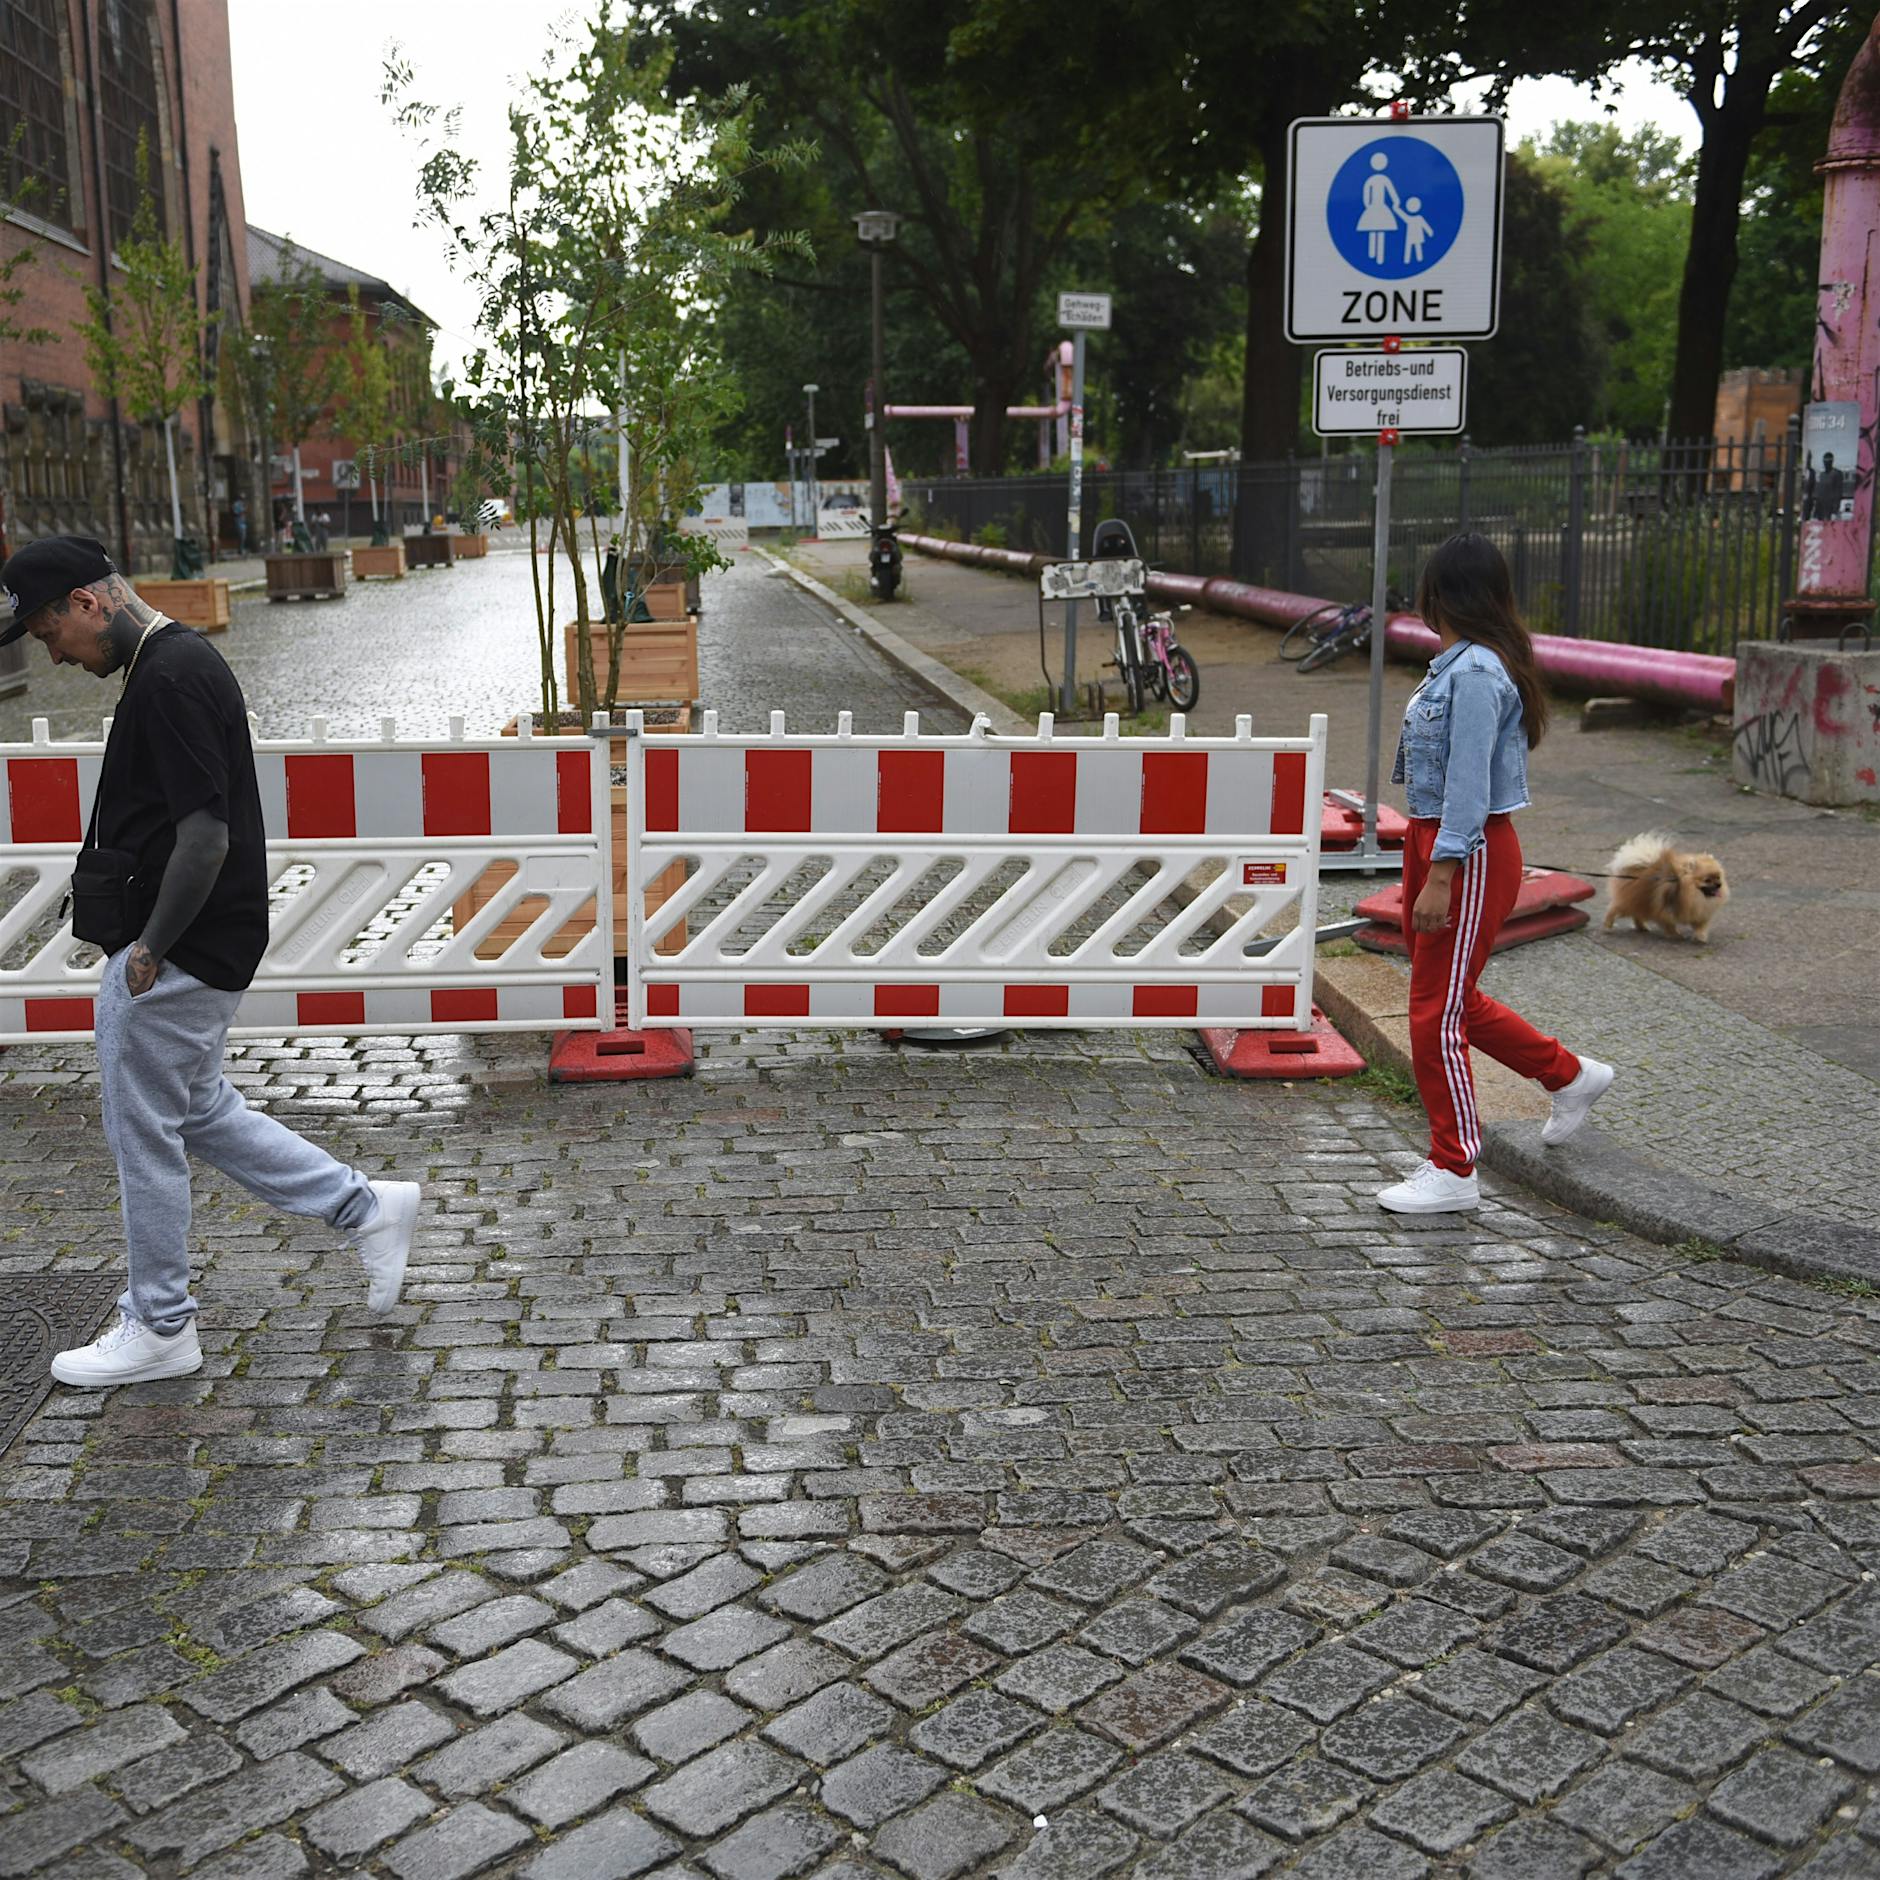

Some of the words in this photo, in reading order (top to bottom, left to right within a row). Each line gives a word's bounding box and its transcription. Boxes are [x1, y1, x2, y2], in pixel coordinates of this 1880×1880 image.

[1341, 290, 1443, 324] ZONE
[1327, 384, 1451, 404] Versorgungsdienst
[1377, 410, 1400, 426] frei
